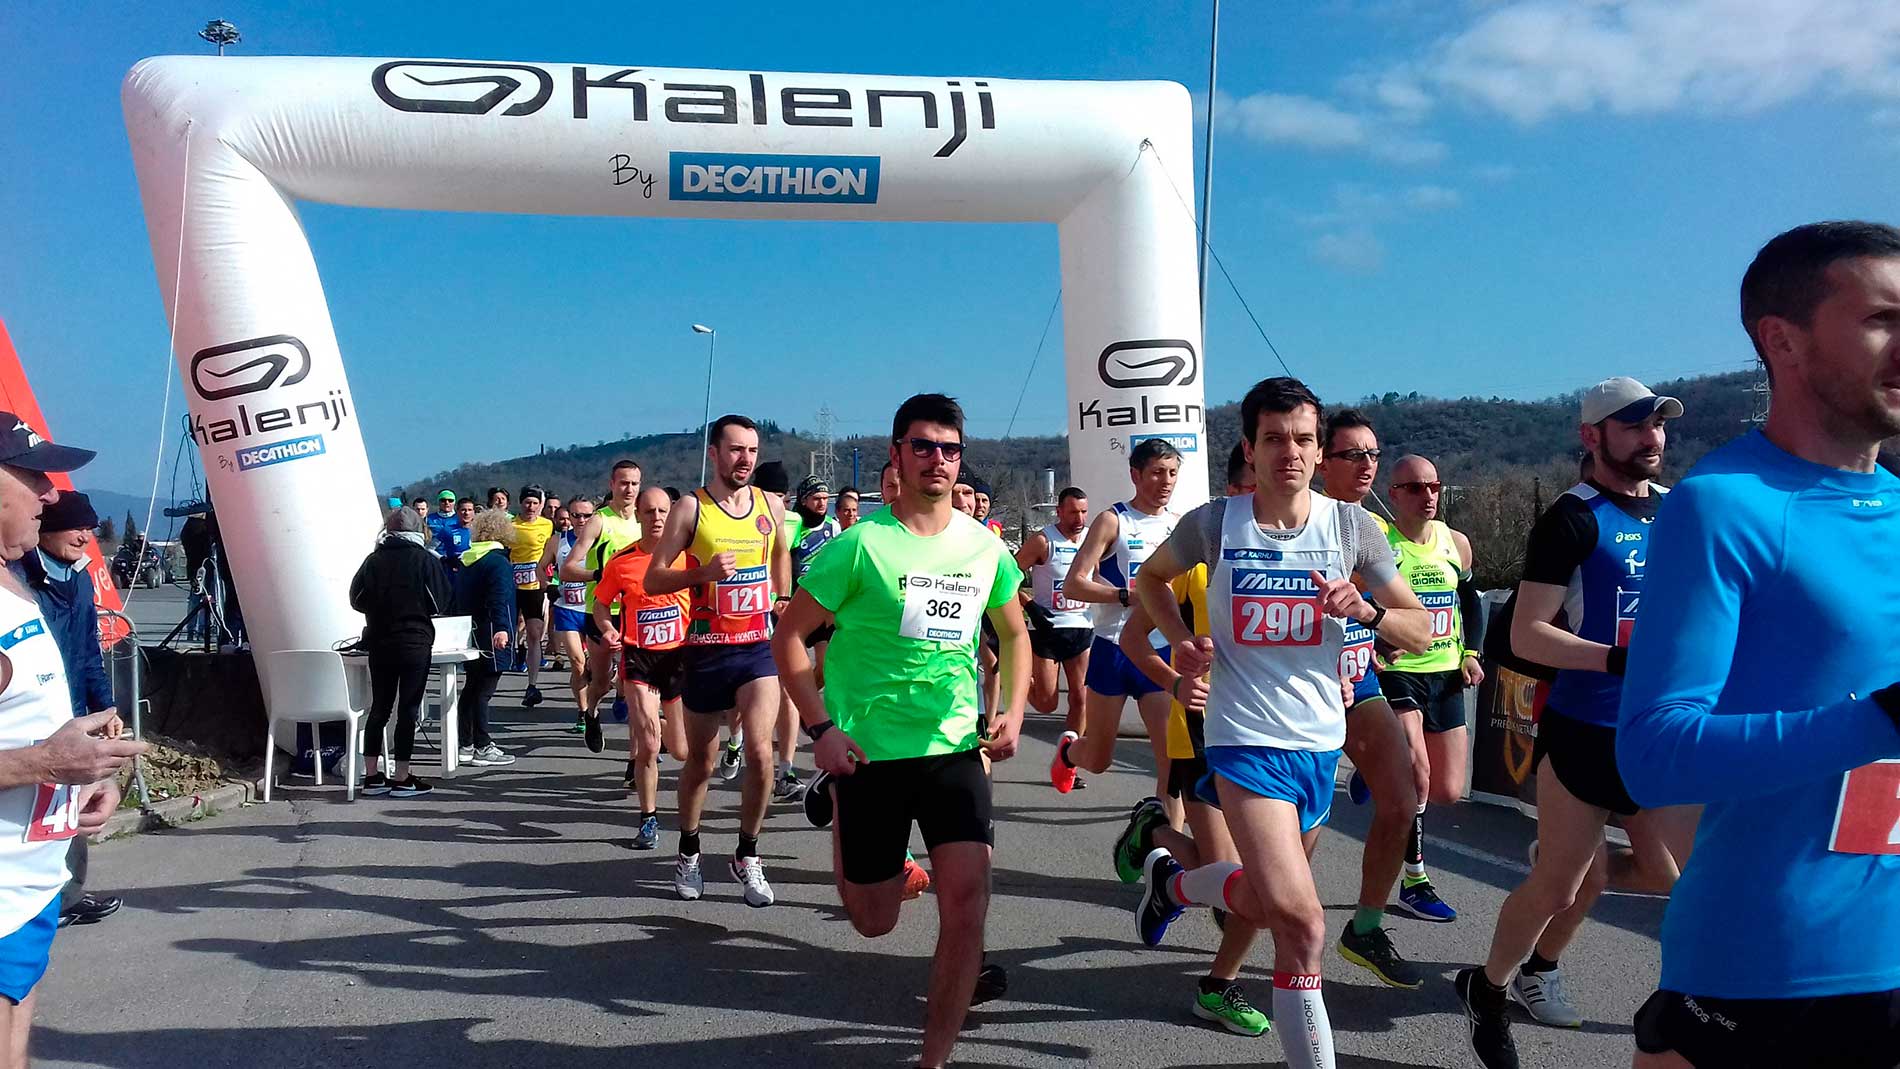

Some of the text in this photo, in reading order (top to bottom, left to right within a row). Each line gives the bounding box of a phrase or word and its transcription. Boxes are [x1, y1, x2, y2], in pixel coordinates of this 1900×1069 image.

[573, 66, 996, 158] Kalenji
[609, 154, 868, 199] By DECATHLON
[217, 438, 321, 472] By DECATHLON
[1109, 438, 1125, 454] By
[1412, 577, 1445, 585] GIORNI
[727, 587, 764, 612] 121
[926, 599, 961, 619] 362
[643, 622, 676, 645] 267
[1241, 602, 1314, 642] 290
[1340, 647, 1370, 678] 69
